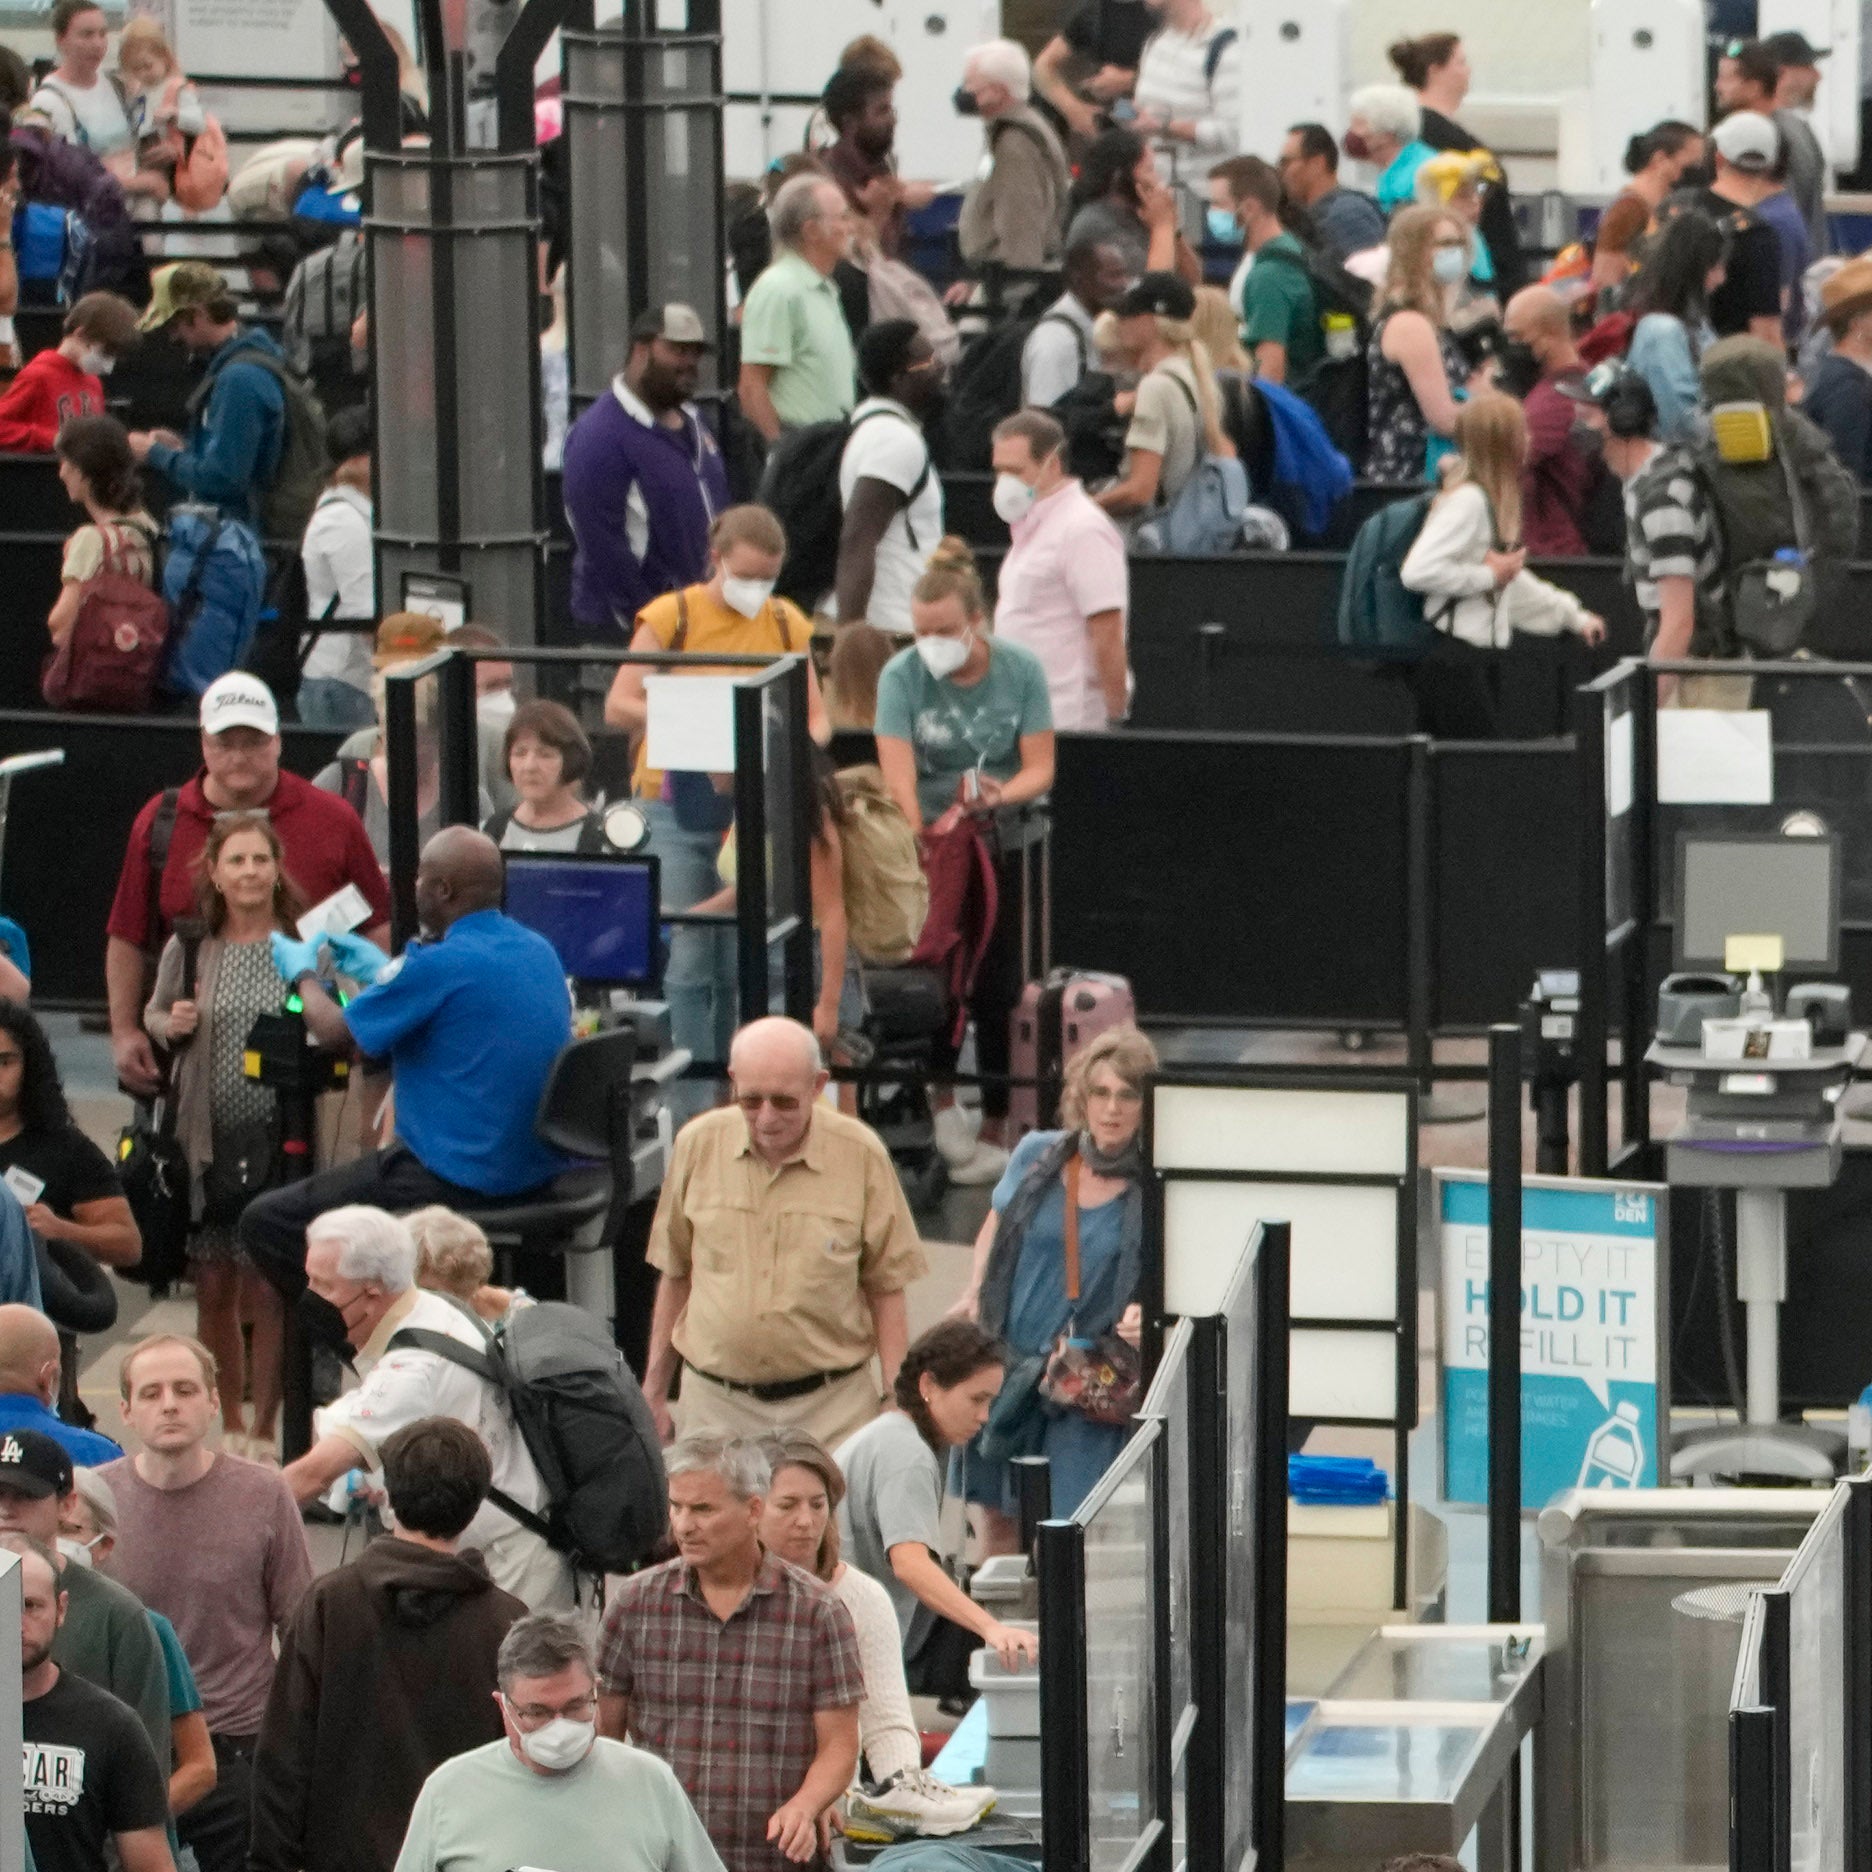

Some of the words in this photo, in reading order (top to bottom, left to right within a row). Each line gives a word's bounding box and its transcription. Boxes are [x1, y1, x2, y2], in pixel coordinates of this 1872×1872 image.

[1465, 1234, 1593, 1278] EPTY
[1606, 1246, 1638, 1279] IT
[1465, 1278, 1585, 1322] HLD
[1599, 1288, 1637, 1326] IT
[1465, 1325, 1593, 1367] RFILL
[1605, 1335, 1637, 1369] IT
[1, 1435, 24, 1463] LA
[23, 1752, 68, 1787] AR
